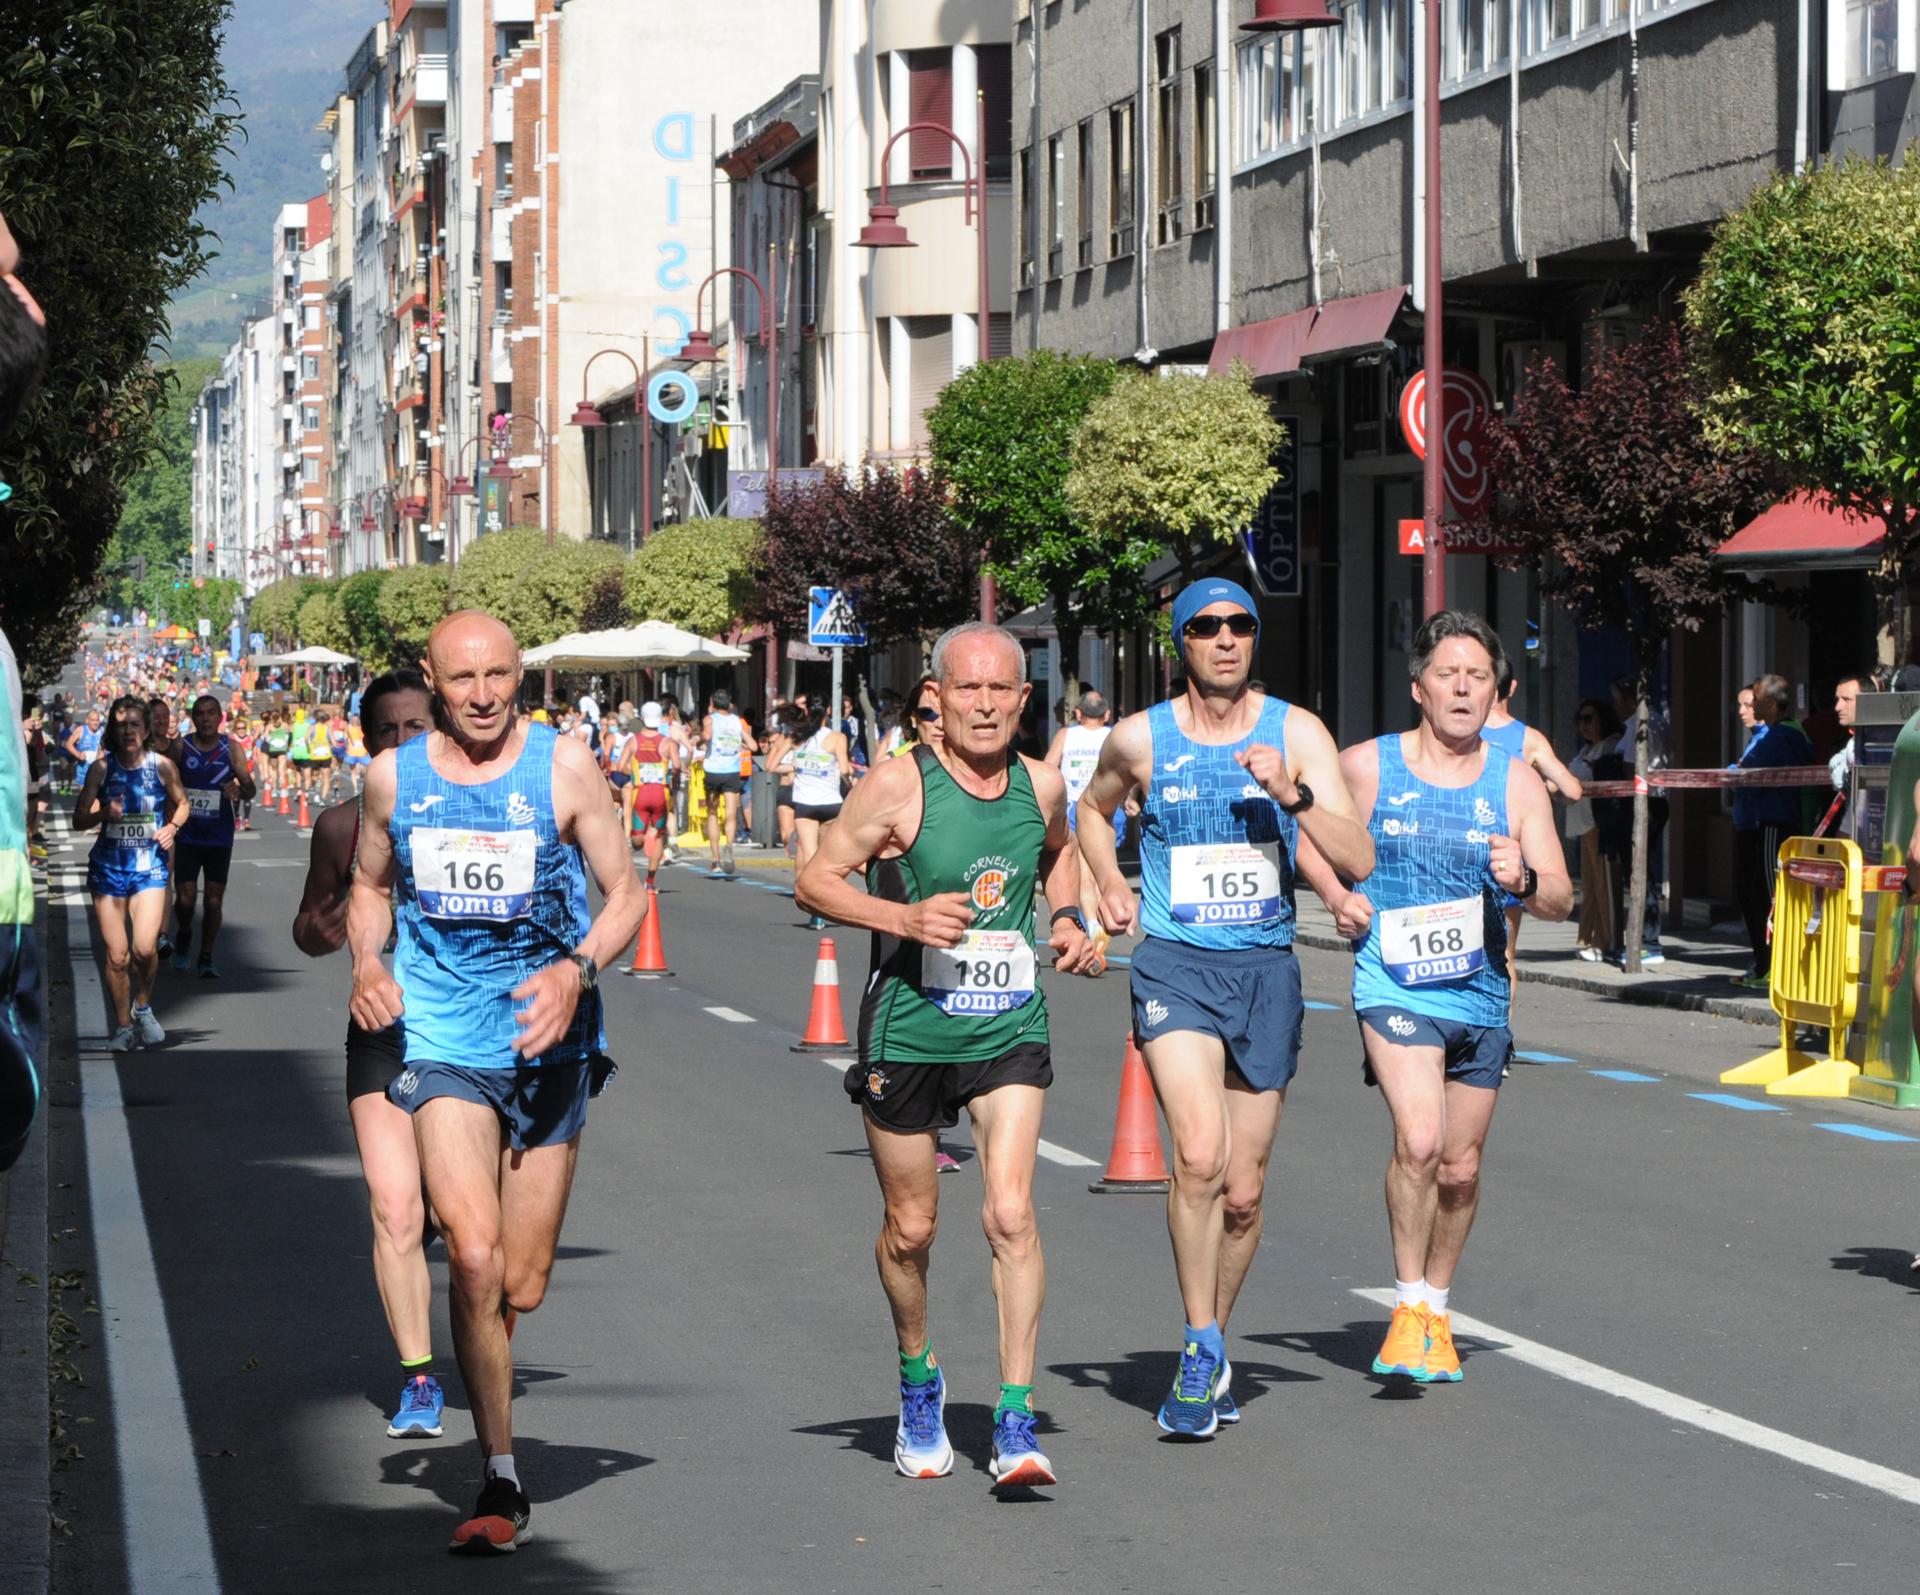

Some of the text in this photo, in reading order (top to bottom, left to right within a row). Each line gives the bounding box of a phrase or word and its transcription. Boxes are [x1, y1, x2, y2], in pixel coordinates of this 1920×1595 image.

[190, 797, 210, 809] 147
[191, 809, 210, 817] oma
[119, 825, 145, 837] 100
[443, 861, 504, 891] 166
[1202, 871, 1259, 898] 165
[1409, 927, 1464, 957] 168
[954, 960, 1011, 988] 180
